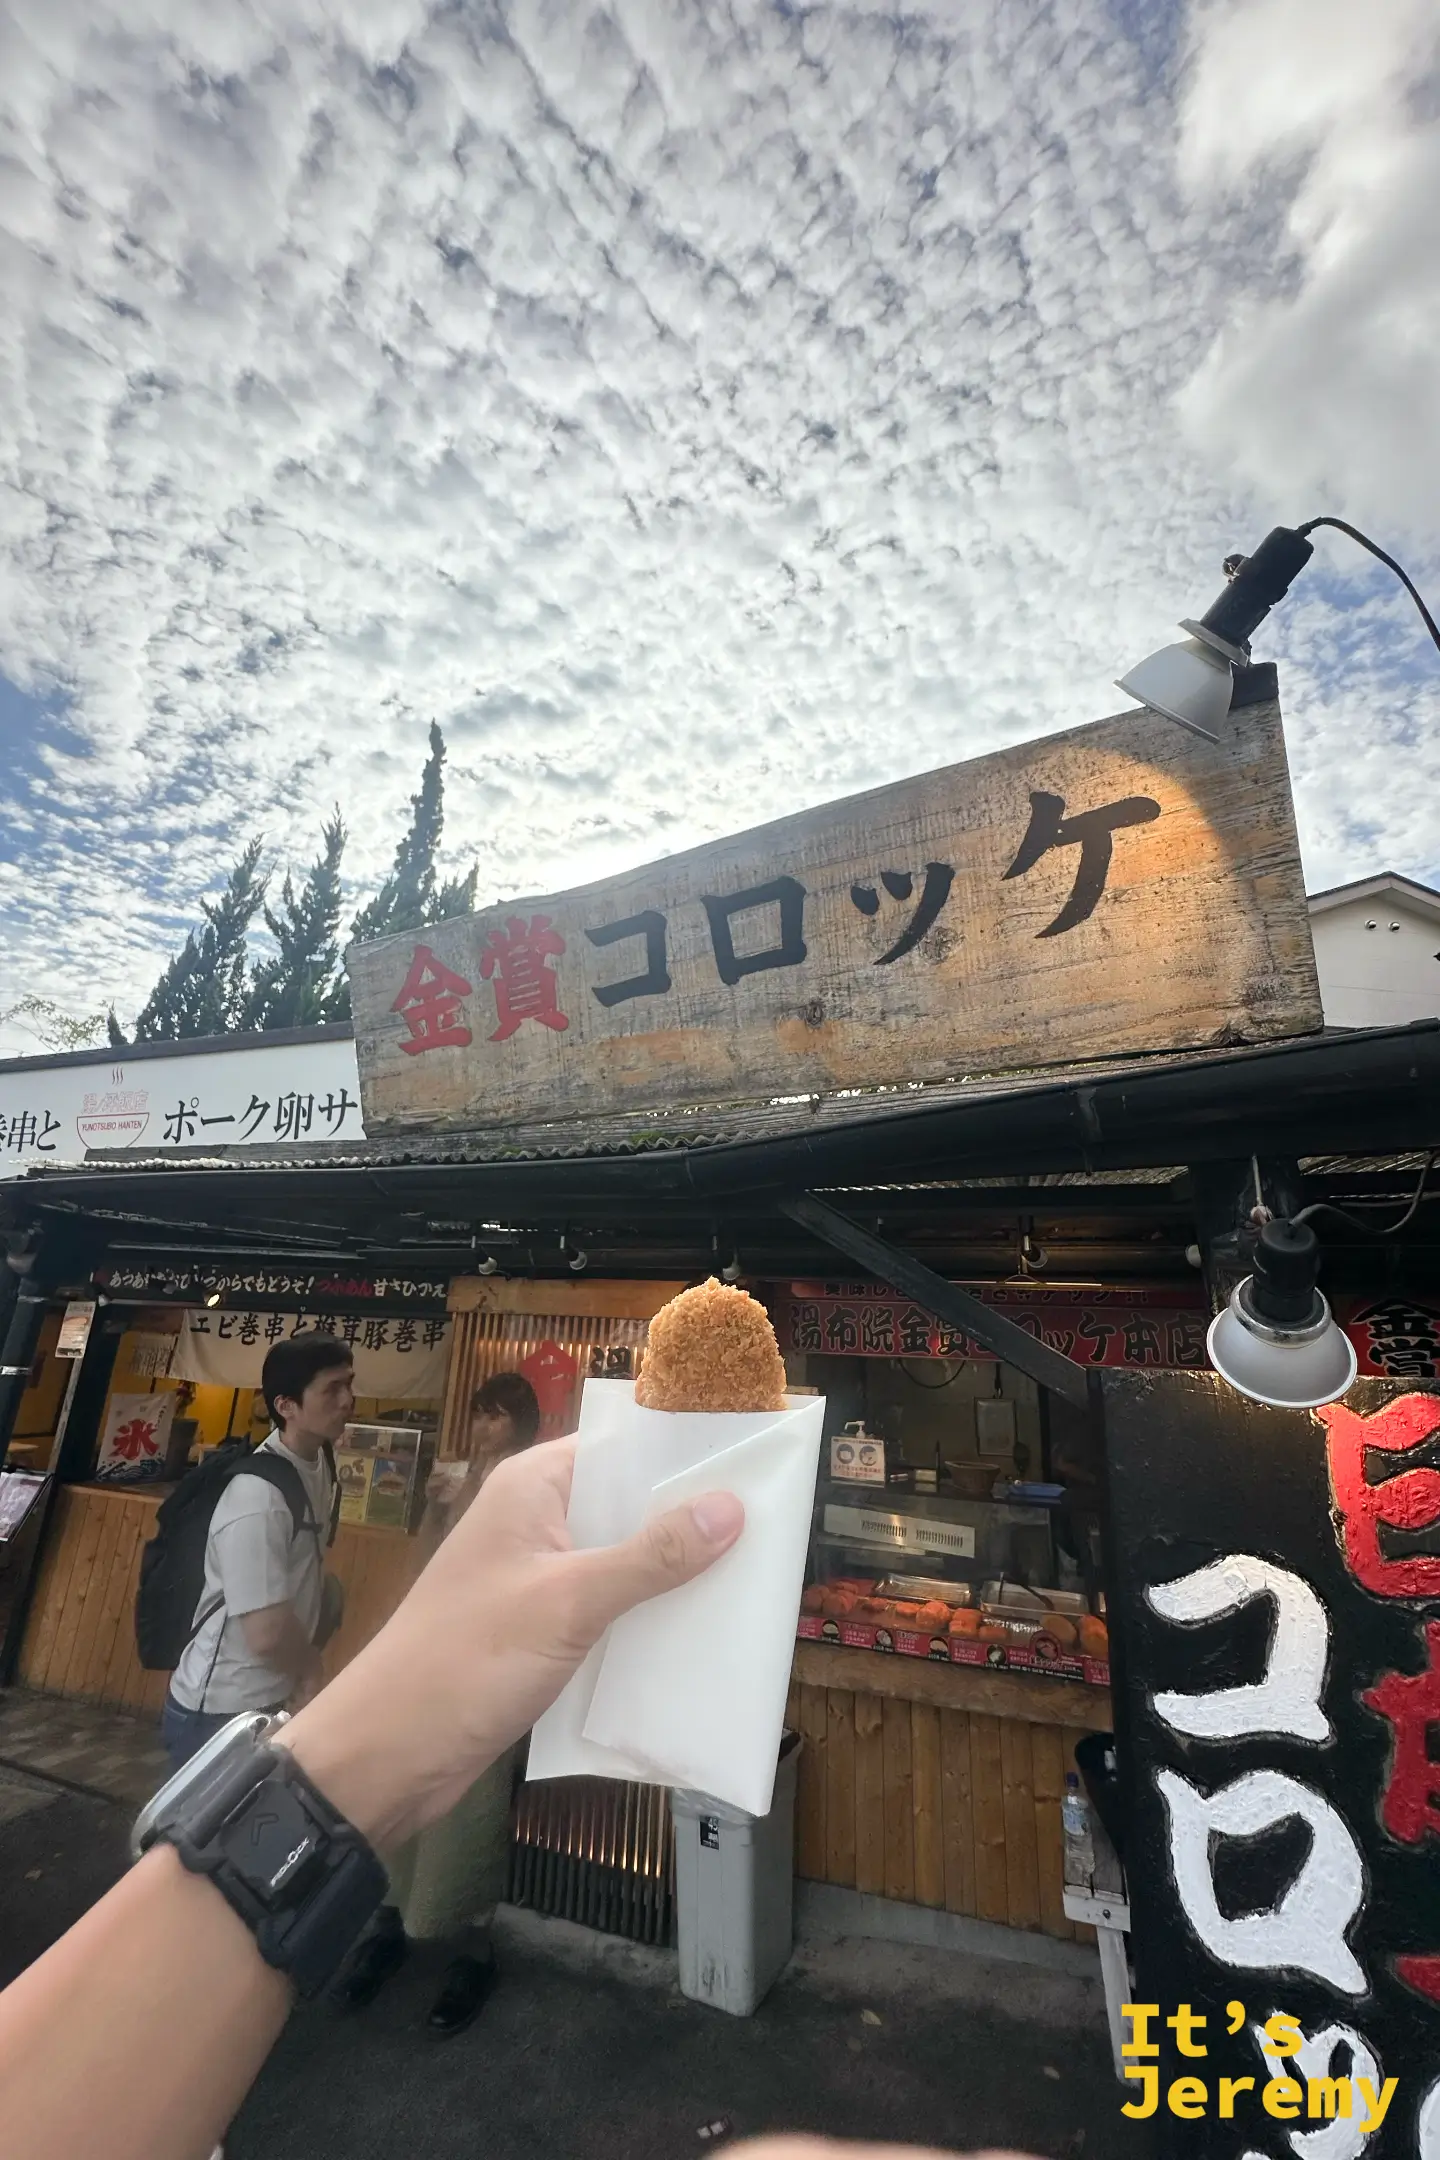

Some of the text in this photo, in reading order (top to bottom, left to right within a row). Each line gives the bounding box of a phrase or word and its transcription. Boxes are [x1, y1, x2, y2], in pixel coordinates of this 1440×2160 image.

[81, 1119, 144, 1132] YUNOTSUBO HANTEN
[163, 1087, 359, 1145] ポーク卵サ
[109, 1418, 159, 1460] 氷
